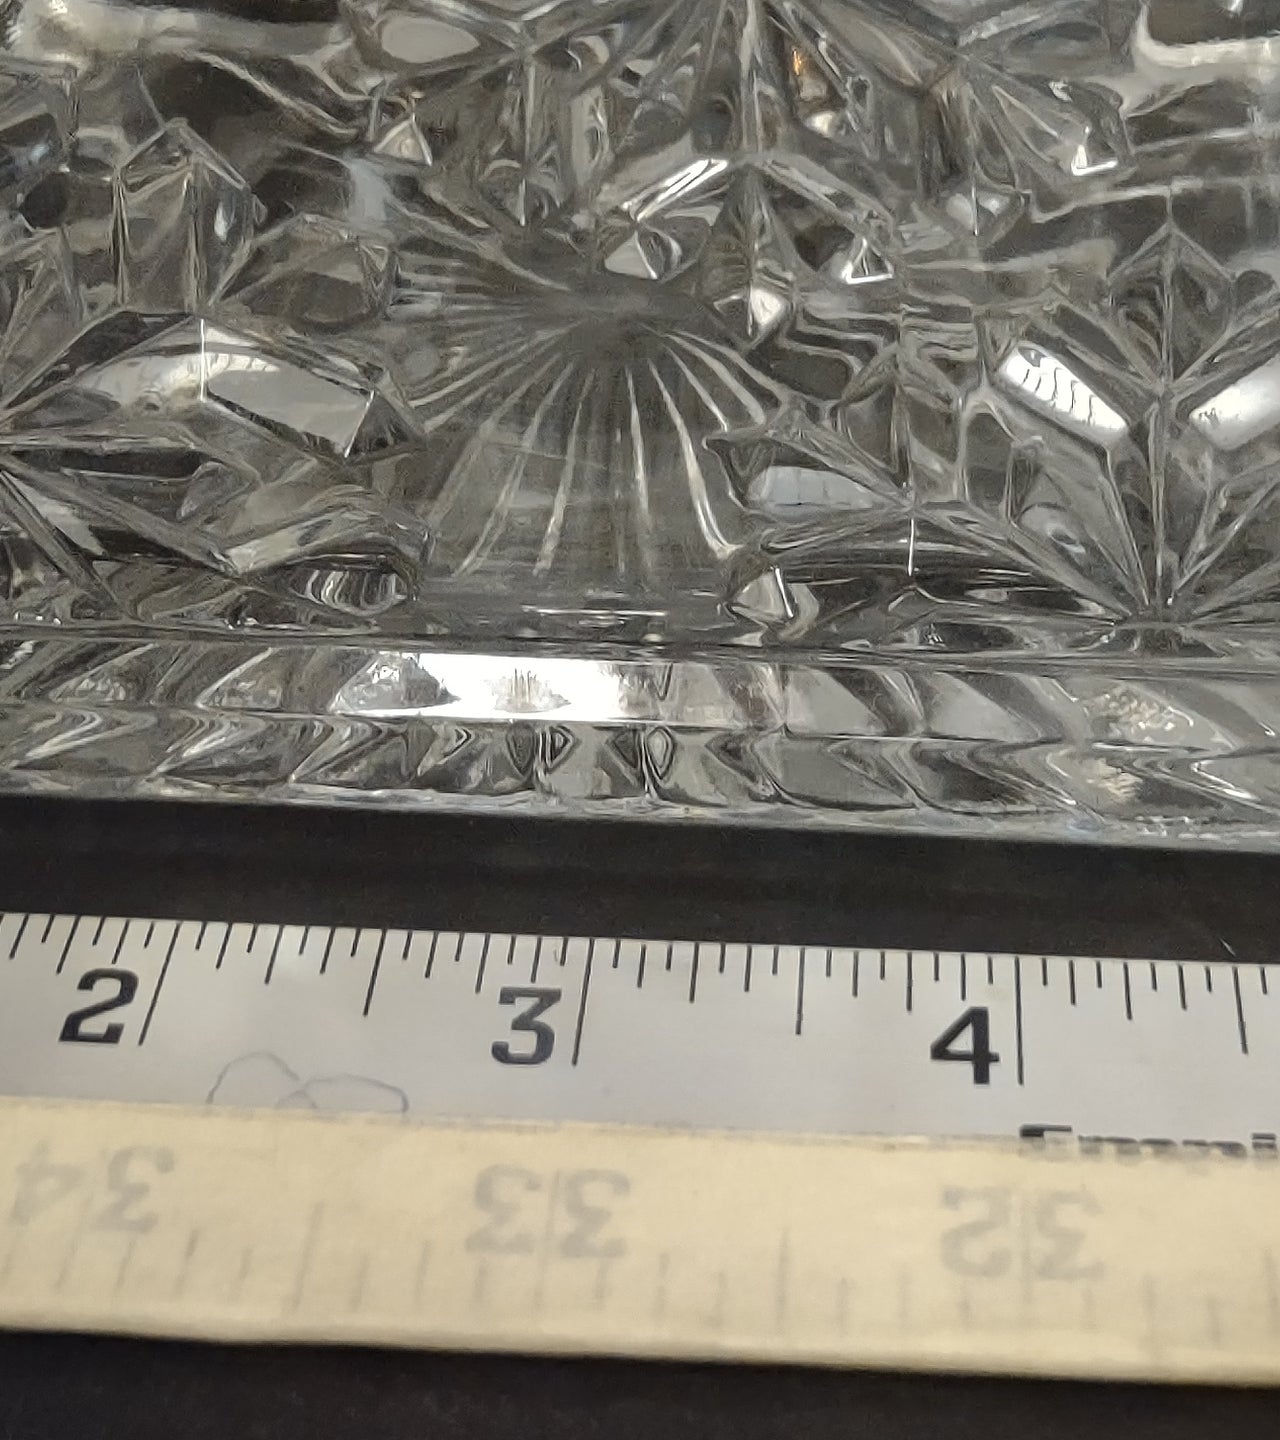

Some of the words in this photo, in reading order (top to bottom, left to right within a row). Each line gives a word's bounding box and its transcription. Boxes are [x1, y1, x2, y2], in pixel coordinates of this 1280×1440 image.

[59, 967, 138, 1045] 2
[491, 985, 563, 1067] 3
[929, 1006, 1001, 1086] 4
